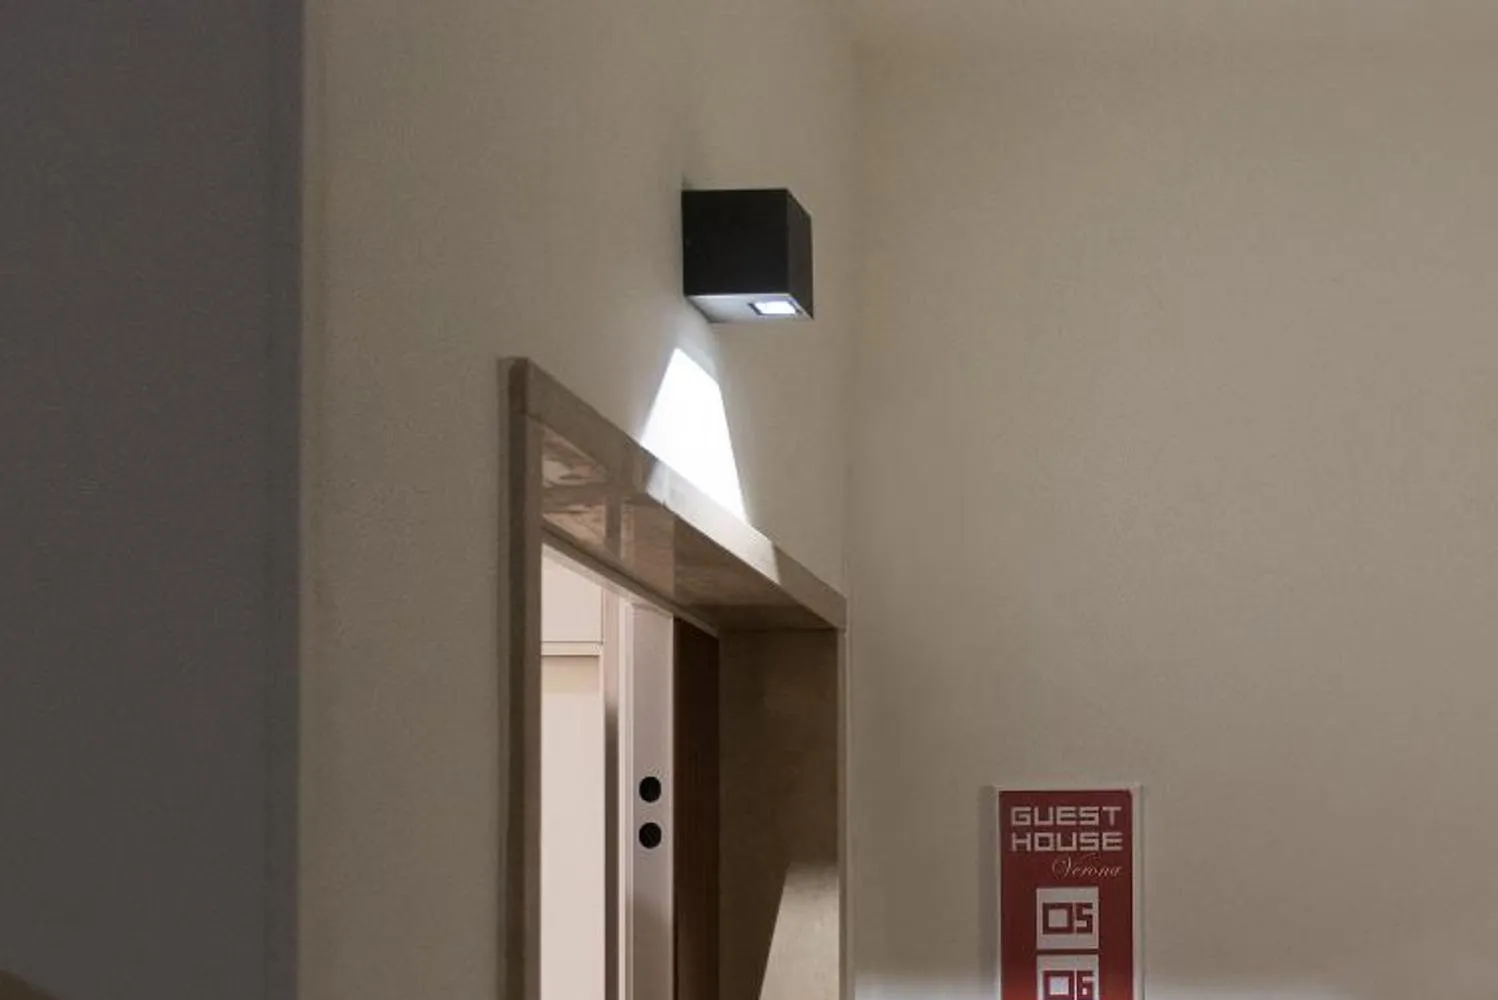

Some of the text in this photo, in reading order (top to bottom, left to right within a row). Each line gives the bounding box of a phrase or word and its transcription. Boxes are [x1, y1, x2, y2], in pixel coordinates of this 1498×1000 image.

[1010, 806, 1122, 826] GUEST
[1011, 832, 1123, 851] HOUSE
[1052, 855, 1123, 880] Verona
[1042, 902, 1094, 934] 05
[1043, 970, 1094, 1000] 06
